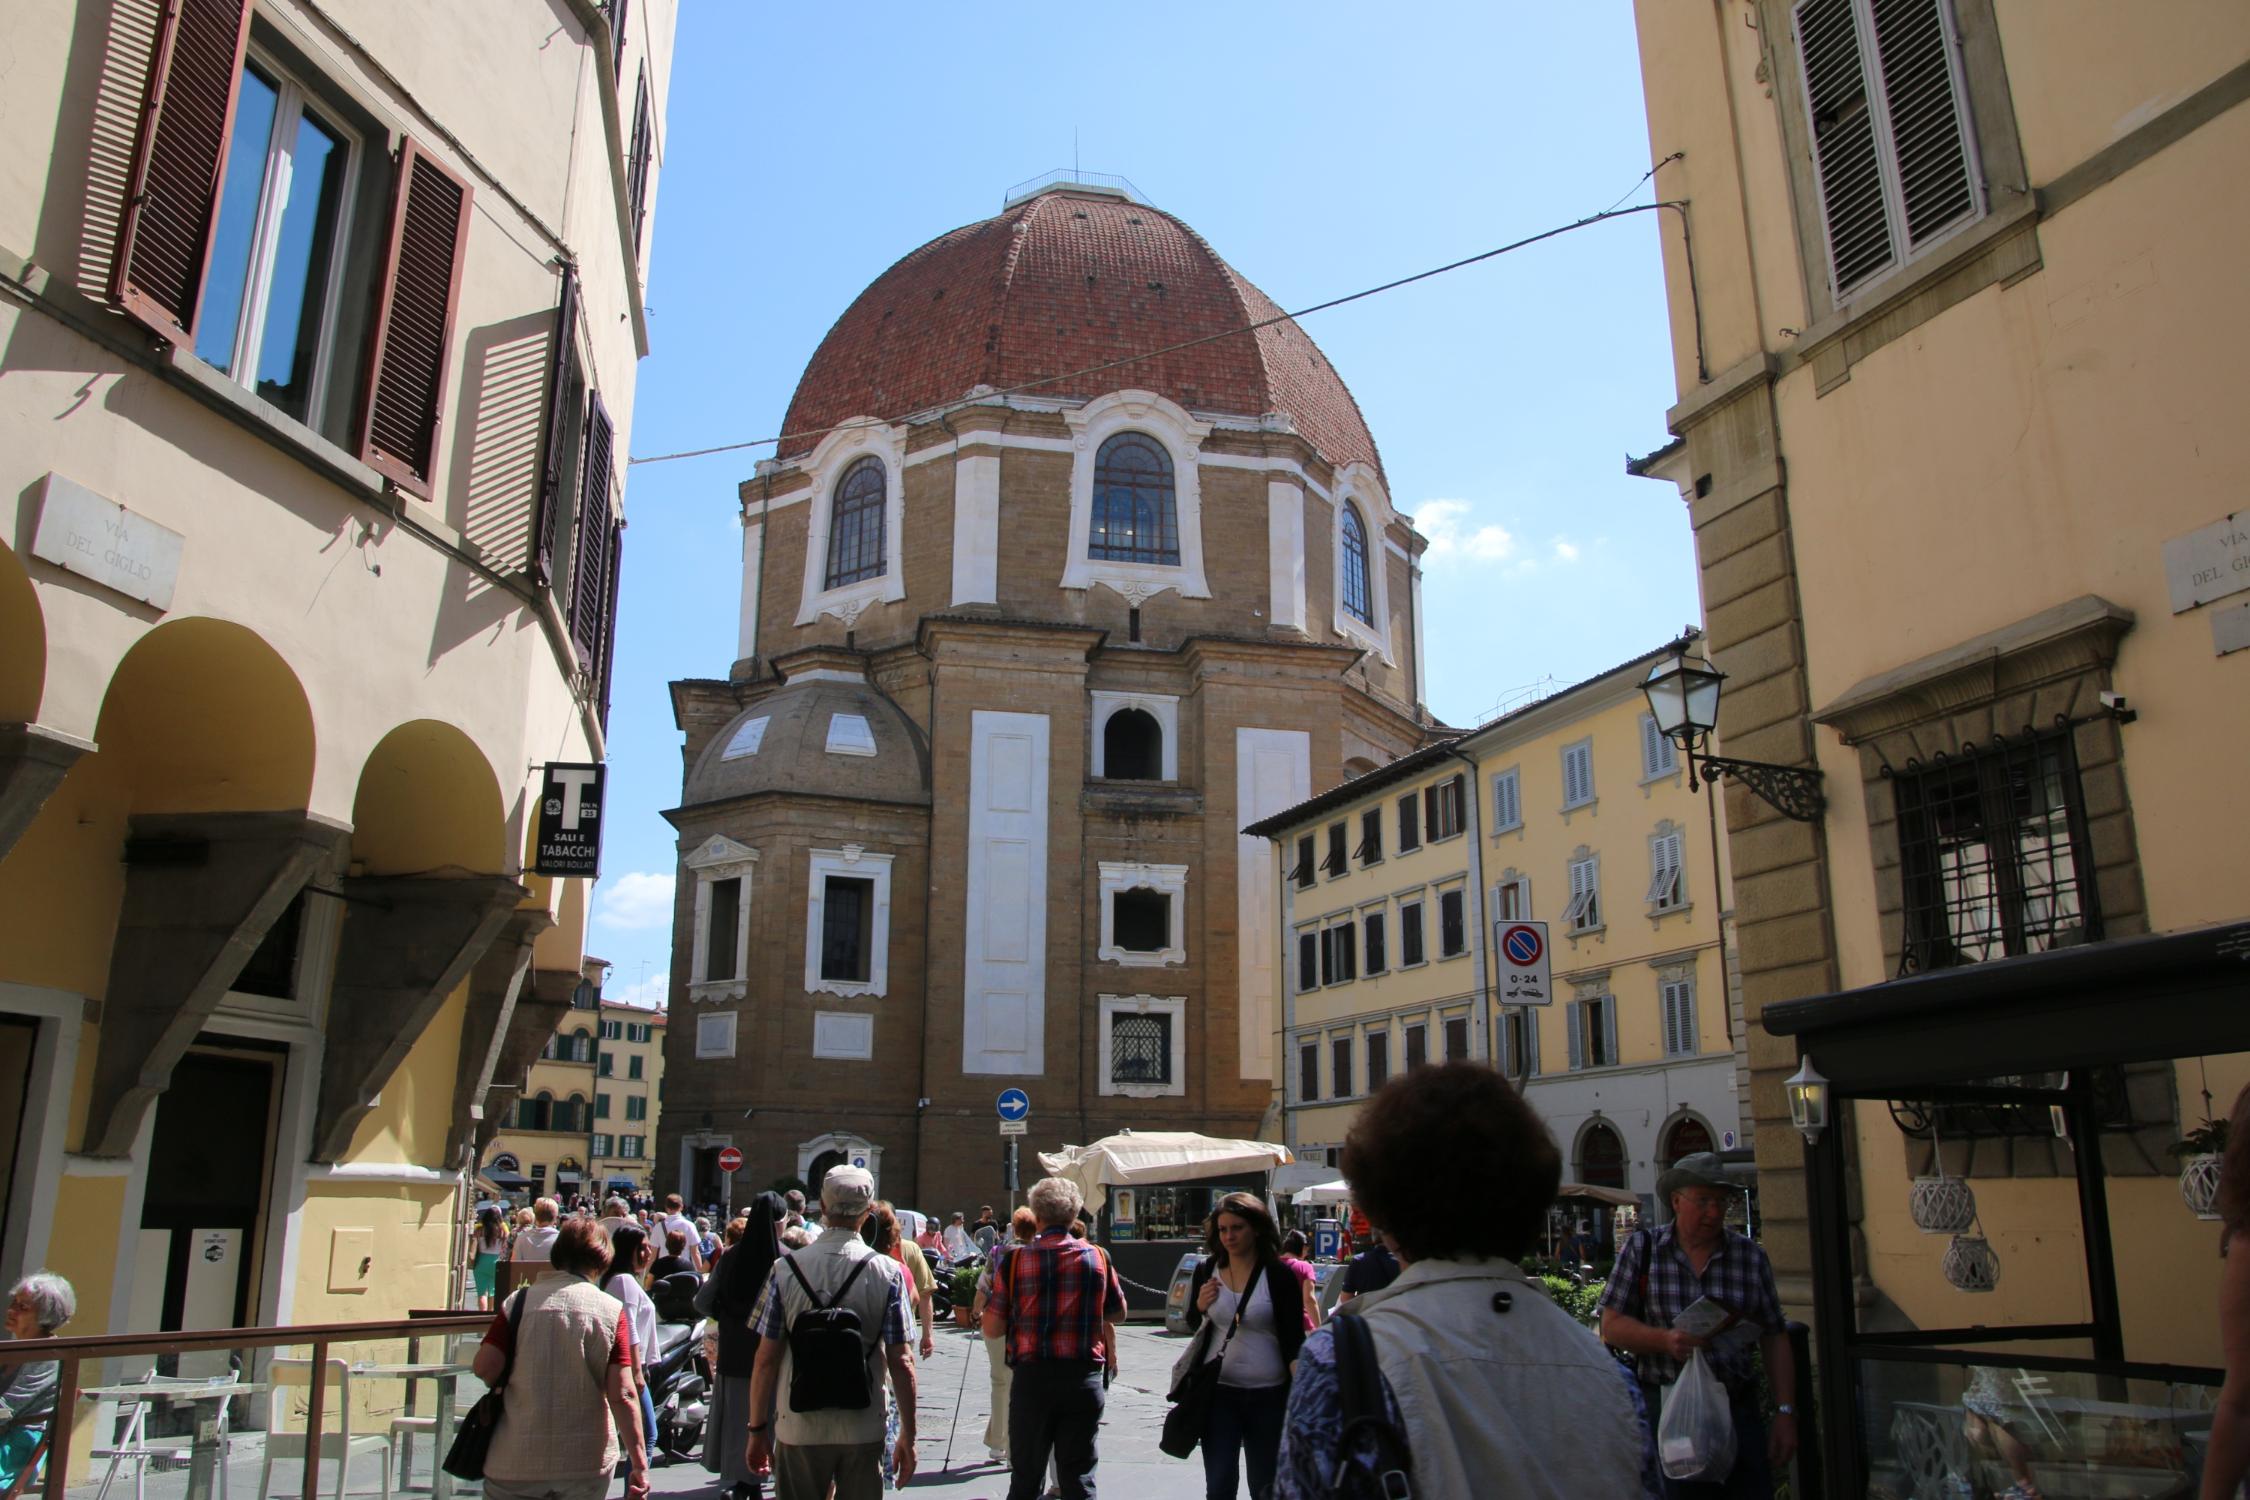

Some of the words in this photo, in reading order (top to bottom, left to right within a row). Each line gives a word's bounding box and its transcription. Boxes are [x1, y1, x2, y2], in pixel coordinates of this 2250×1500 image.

[104, 519, 129, 542] VIA
[2219, 531, 2248, 548] VIA
[66, 531, 95, 557] DEL
[103, 549, 152, 580] GIGLIO
[2192, 566, 2223, 587] DEL
[552, 768, 597, 830] T
[554, 833, 576, 841] SALI
[579, 834, 585, 842] E
[541, 845, 596, 857] TABACCHI
[540, 860, 565, 868] VALORI
[566, 860, 594, 869] BOLLATI
[1320, 1233, 1334, 1253] P
